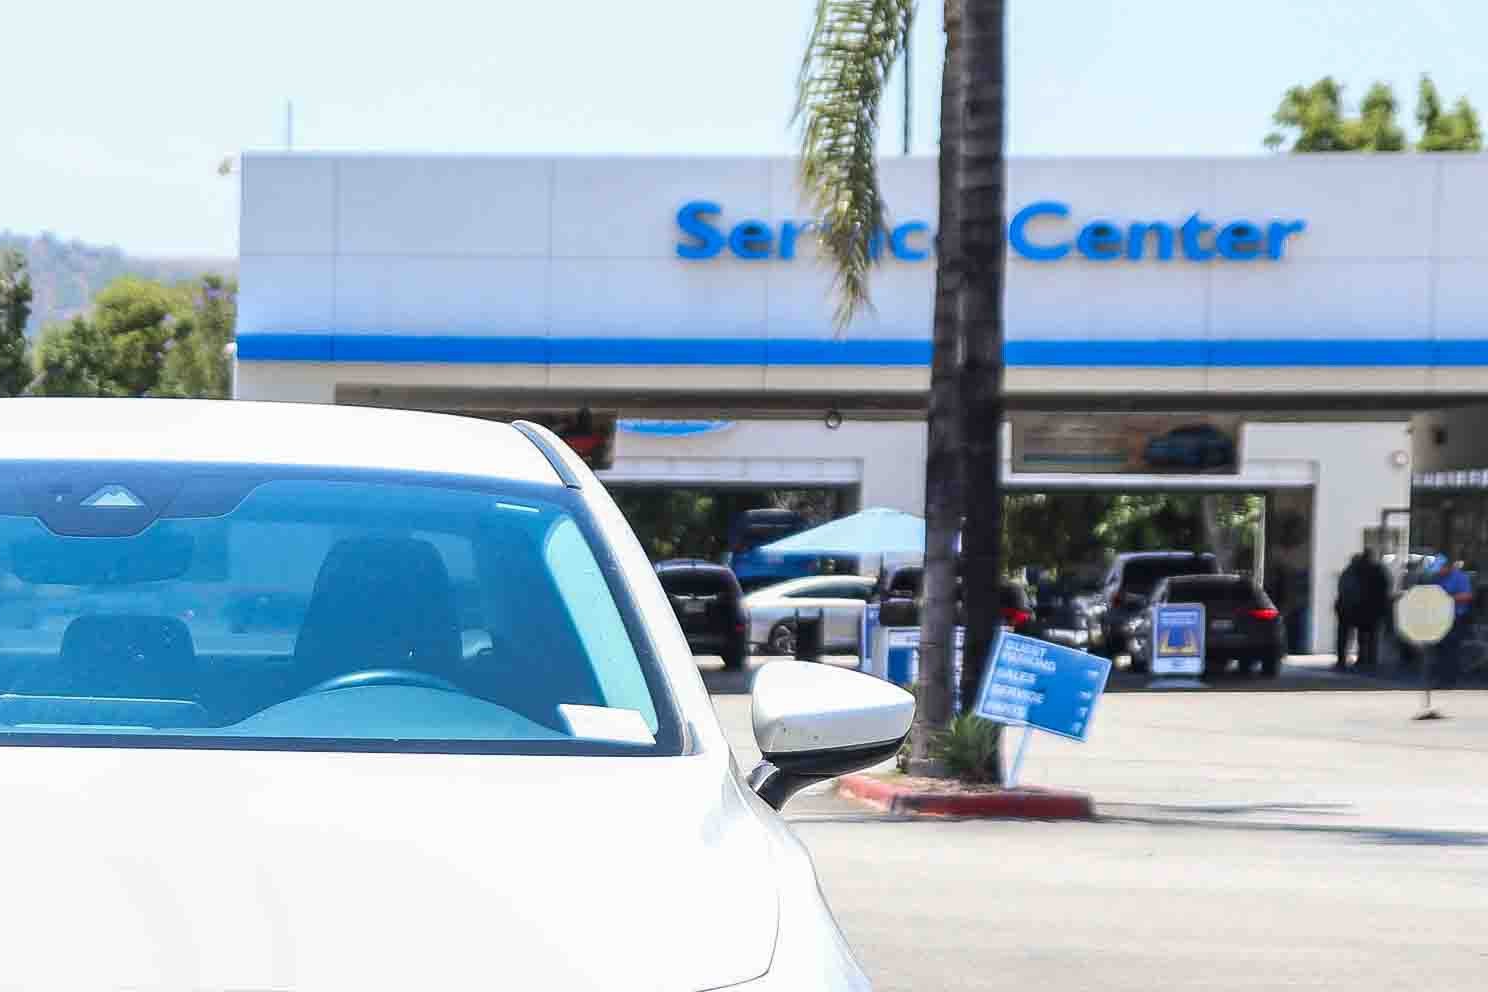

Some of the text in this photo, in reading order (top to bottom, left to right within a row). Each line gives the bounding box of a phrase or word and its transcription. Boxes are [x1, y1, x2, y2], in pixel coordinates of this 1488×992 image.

[1008, 201, 1307, 261] Center
[995, 665, 1037, 686] SALES
[990, 680, 1045, 707] SERVICE
